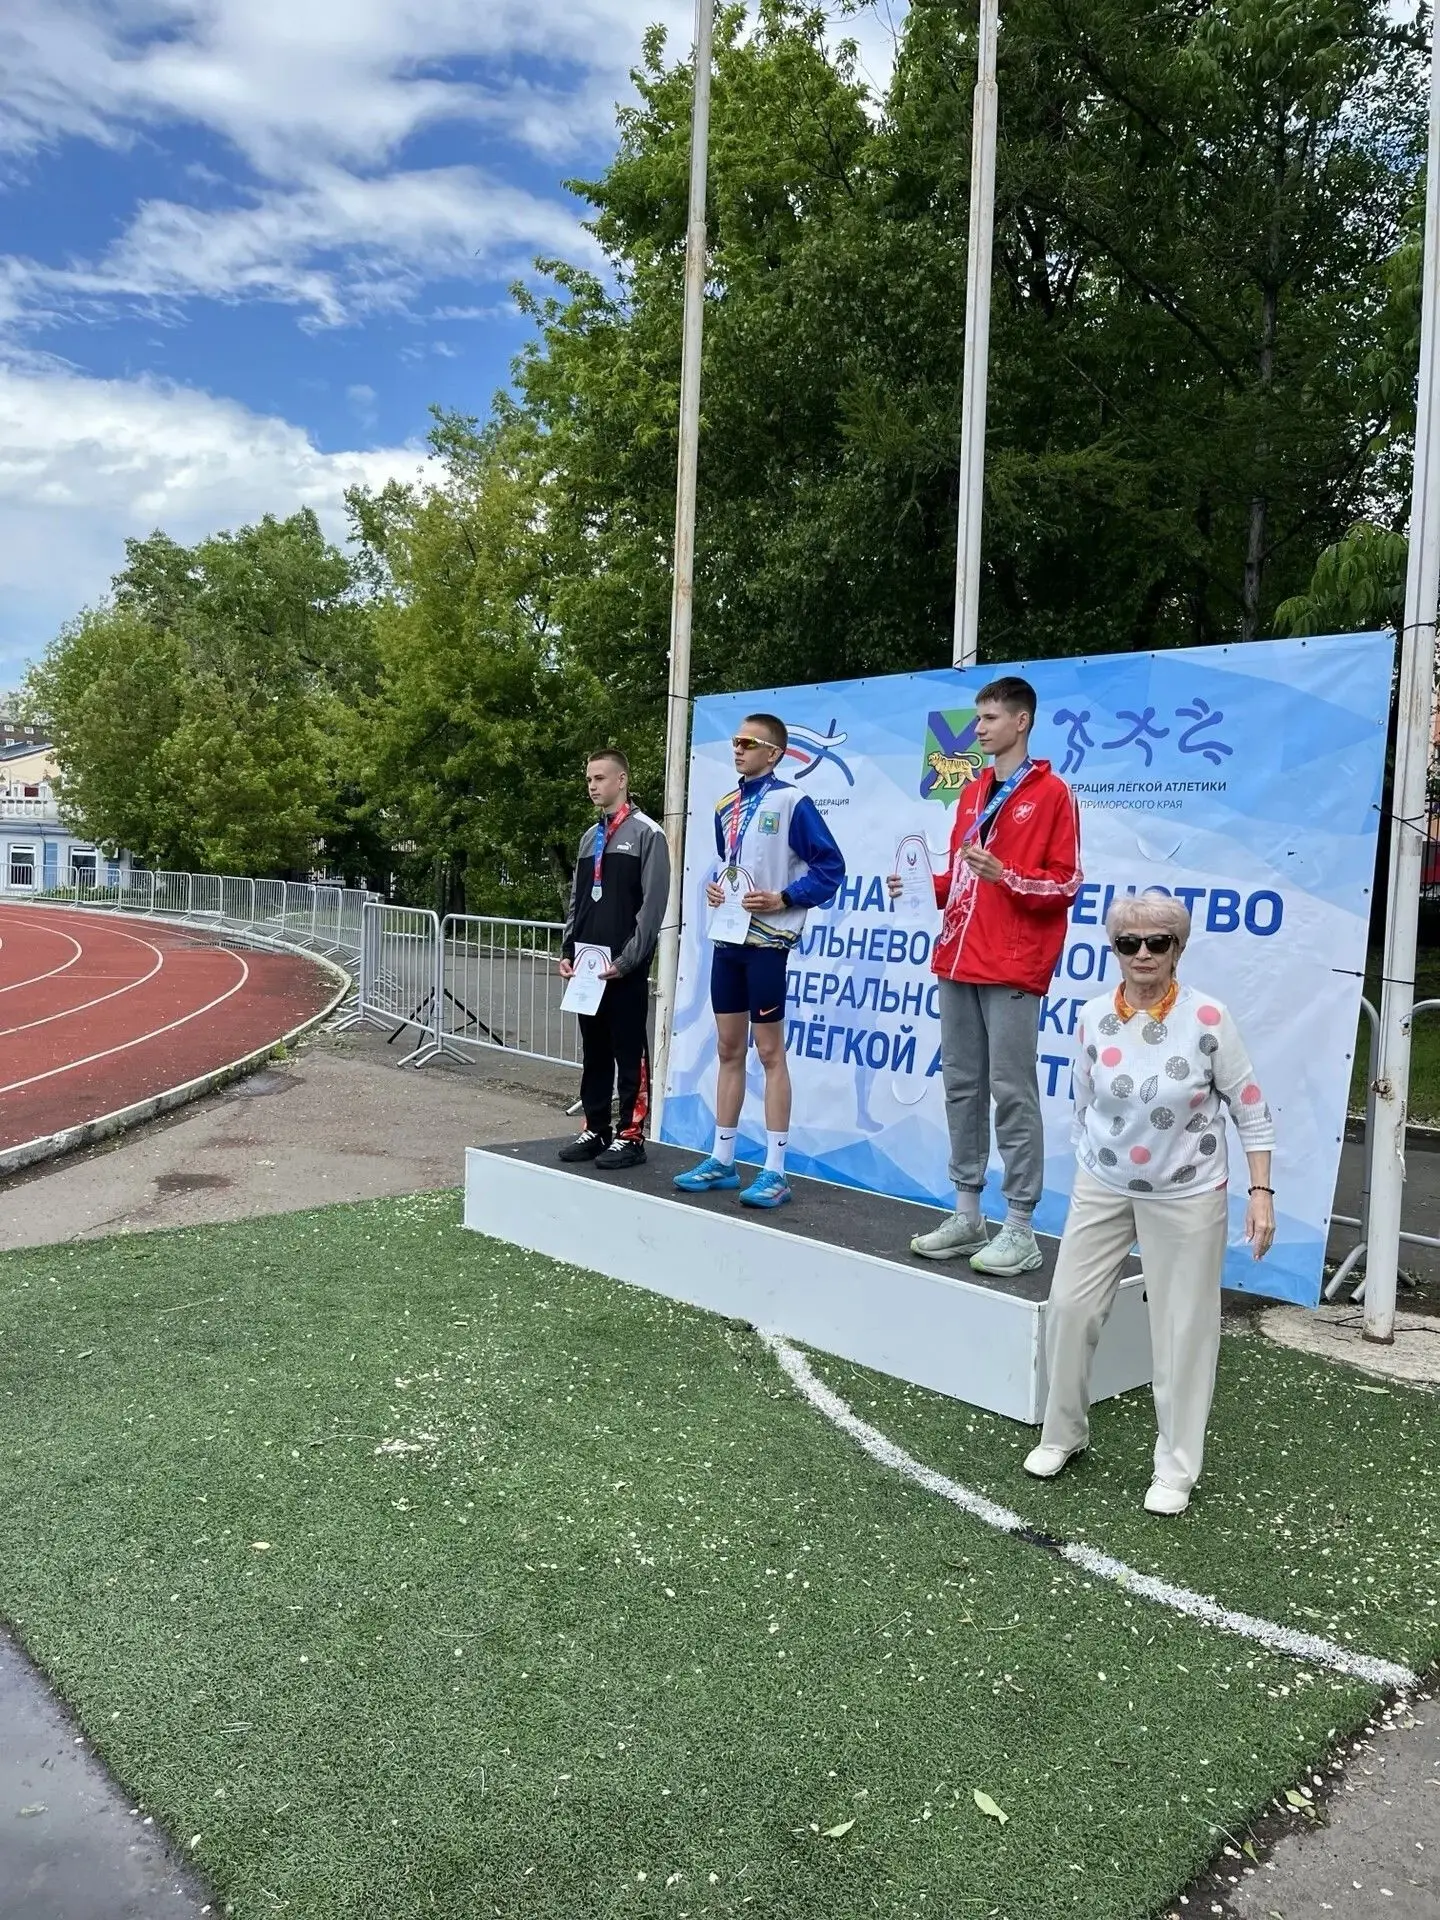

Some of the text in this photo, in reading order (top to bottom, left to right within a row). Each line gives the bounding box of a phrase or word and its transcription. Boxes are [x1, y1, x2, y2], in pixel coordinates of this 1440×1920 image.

[1070, 780, 1227, 795] ЕРАЦИЯ ЛЁГКОЙ АТЛЕТИКИ
[815, 799, 850, 807] ЕДЕРАЦИЯ
[1080, 800, 1183, 809] ПРИМОРСКОГО КРАЯ
[799, 925, 941, 966] ЛЬНЕВО
[786, 970, 941, 1020] ДЕРАЛЬНО
[785, 1014, 917, 1075] ЛЁГКОЙ
